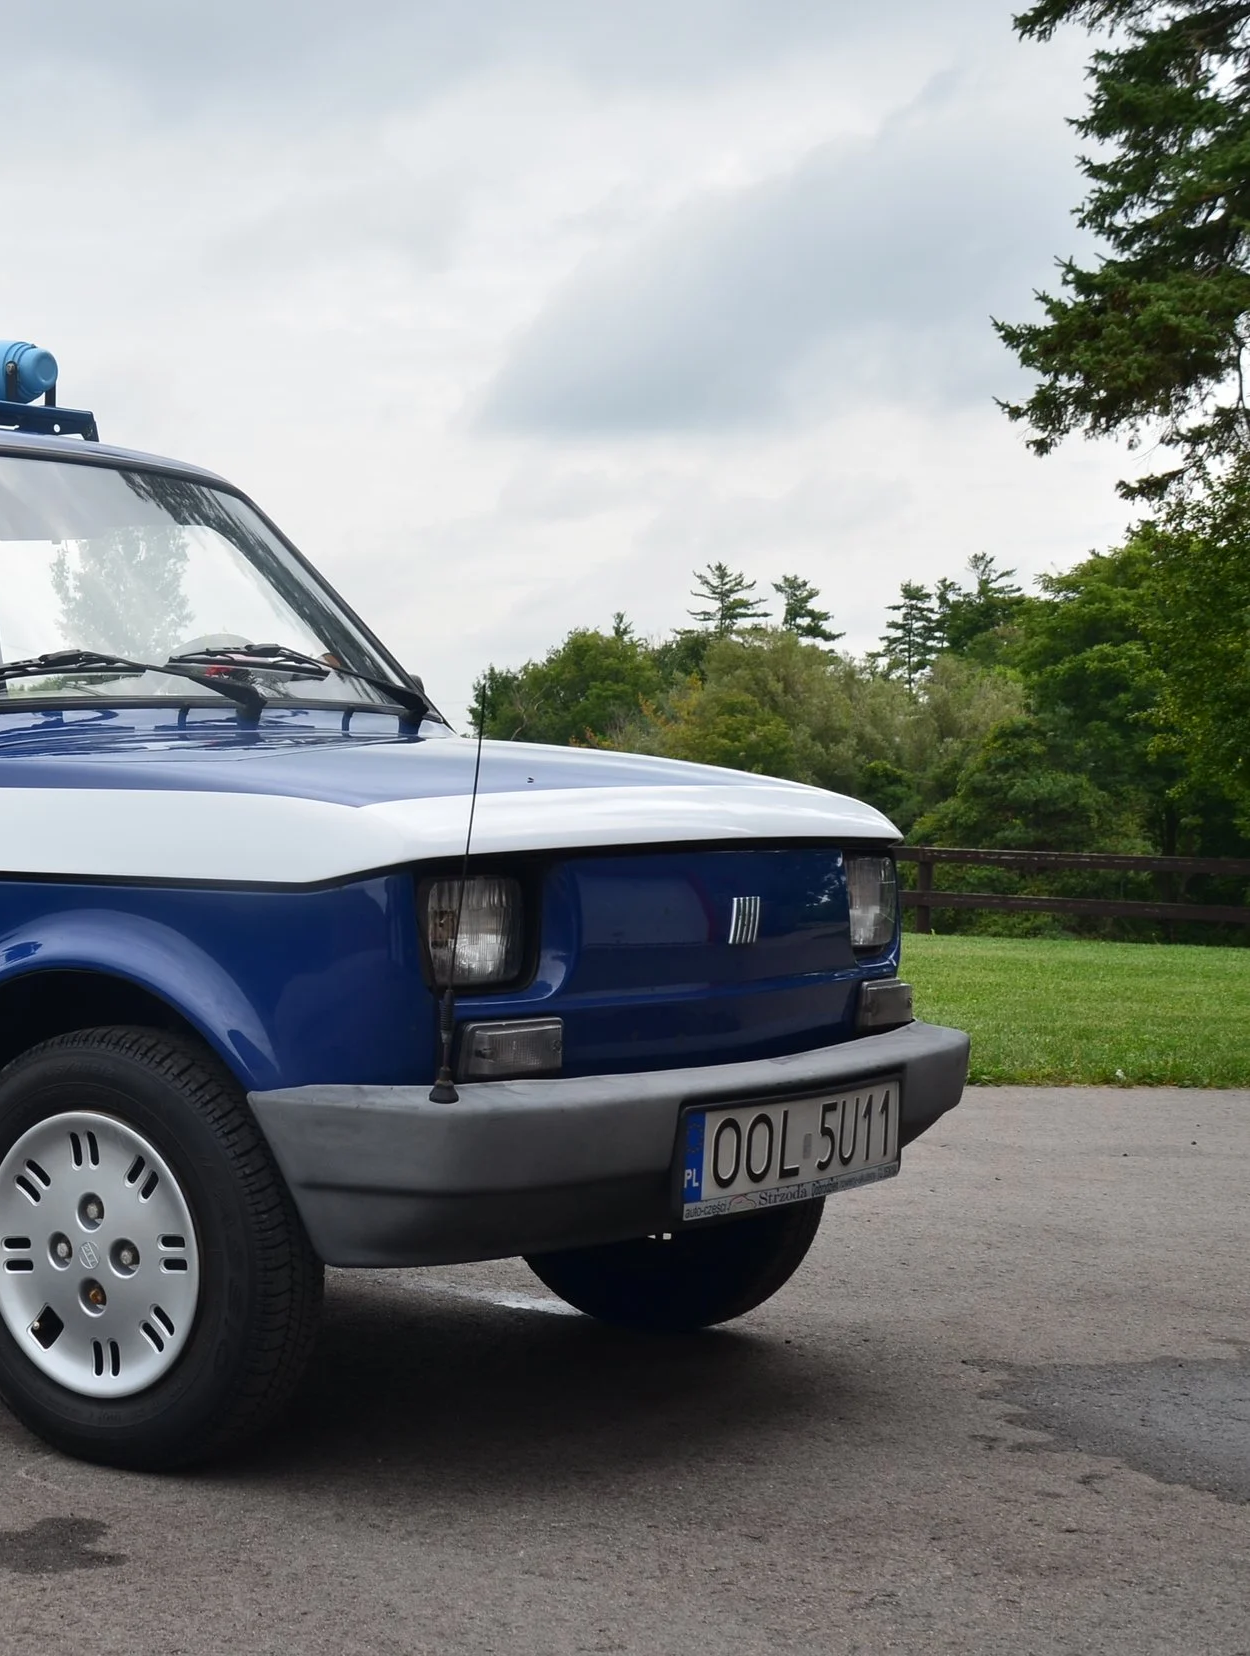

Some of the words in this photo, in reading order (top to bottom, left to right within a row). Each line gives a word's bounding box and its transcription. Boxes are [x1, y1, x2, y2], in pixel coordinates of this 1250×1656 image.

[712, 1109, 800, 1189] OOL
[815, 1089, 890, 1171] 5U11
[684, 1168, 699, 1188] PL
